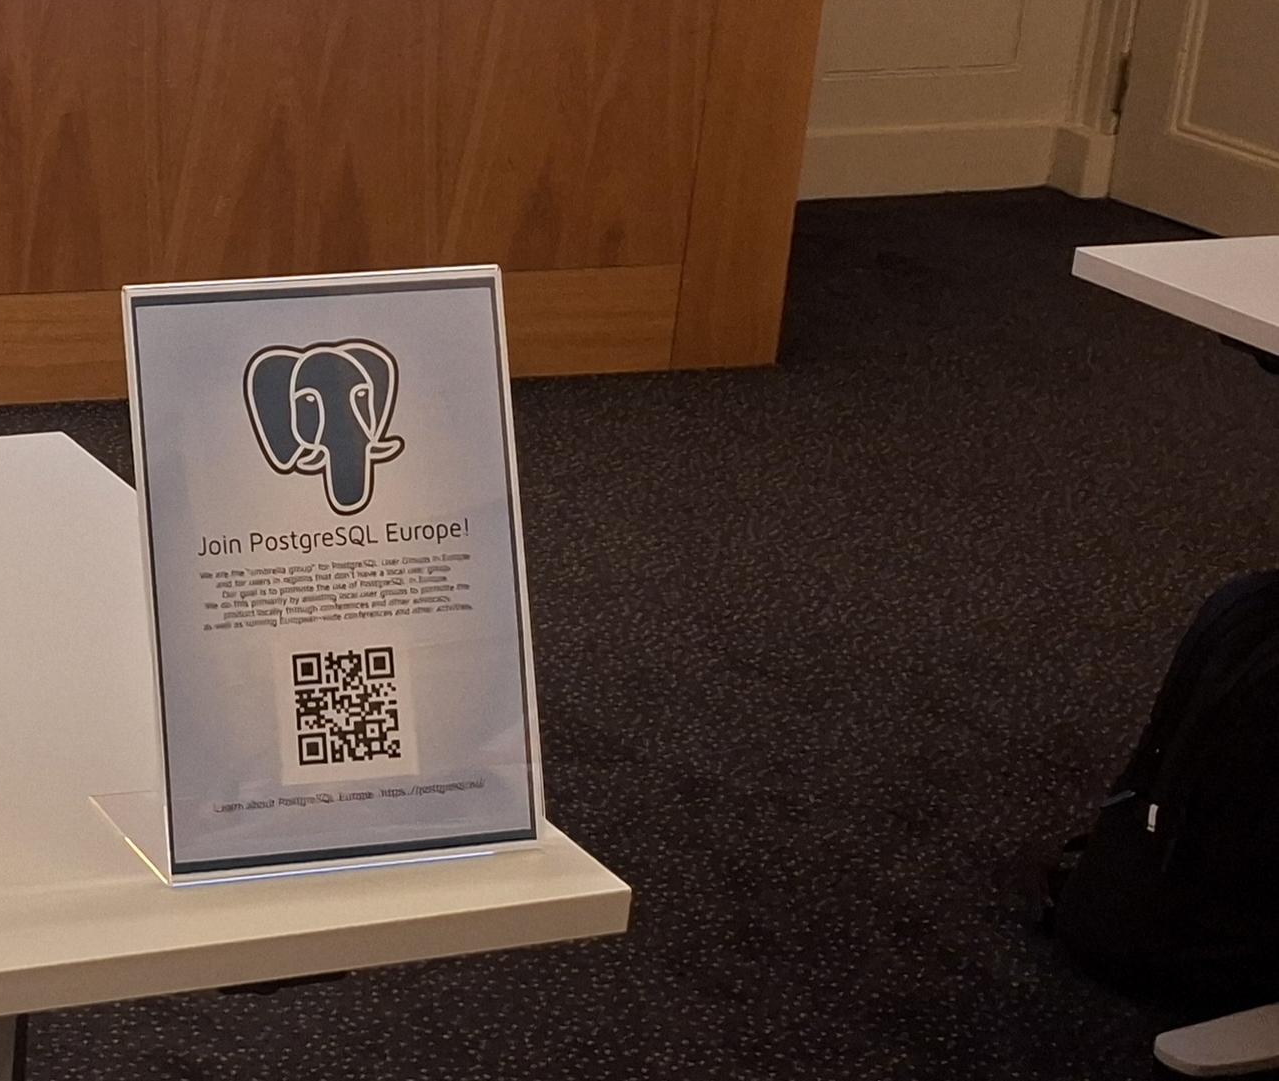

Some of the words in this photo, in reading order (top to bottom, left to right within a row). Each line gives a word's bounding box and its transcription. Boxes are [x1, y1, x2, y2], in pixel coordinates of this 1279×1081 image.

[198, 535, 242, 556] Join
[249, 524, 378, 554] PostgreSQL
[385, 517, 470, 545] Europe!
